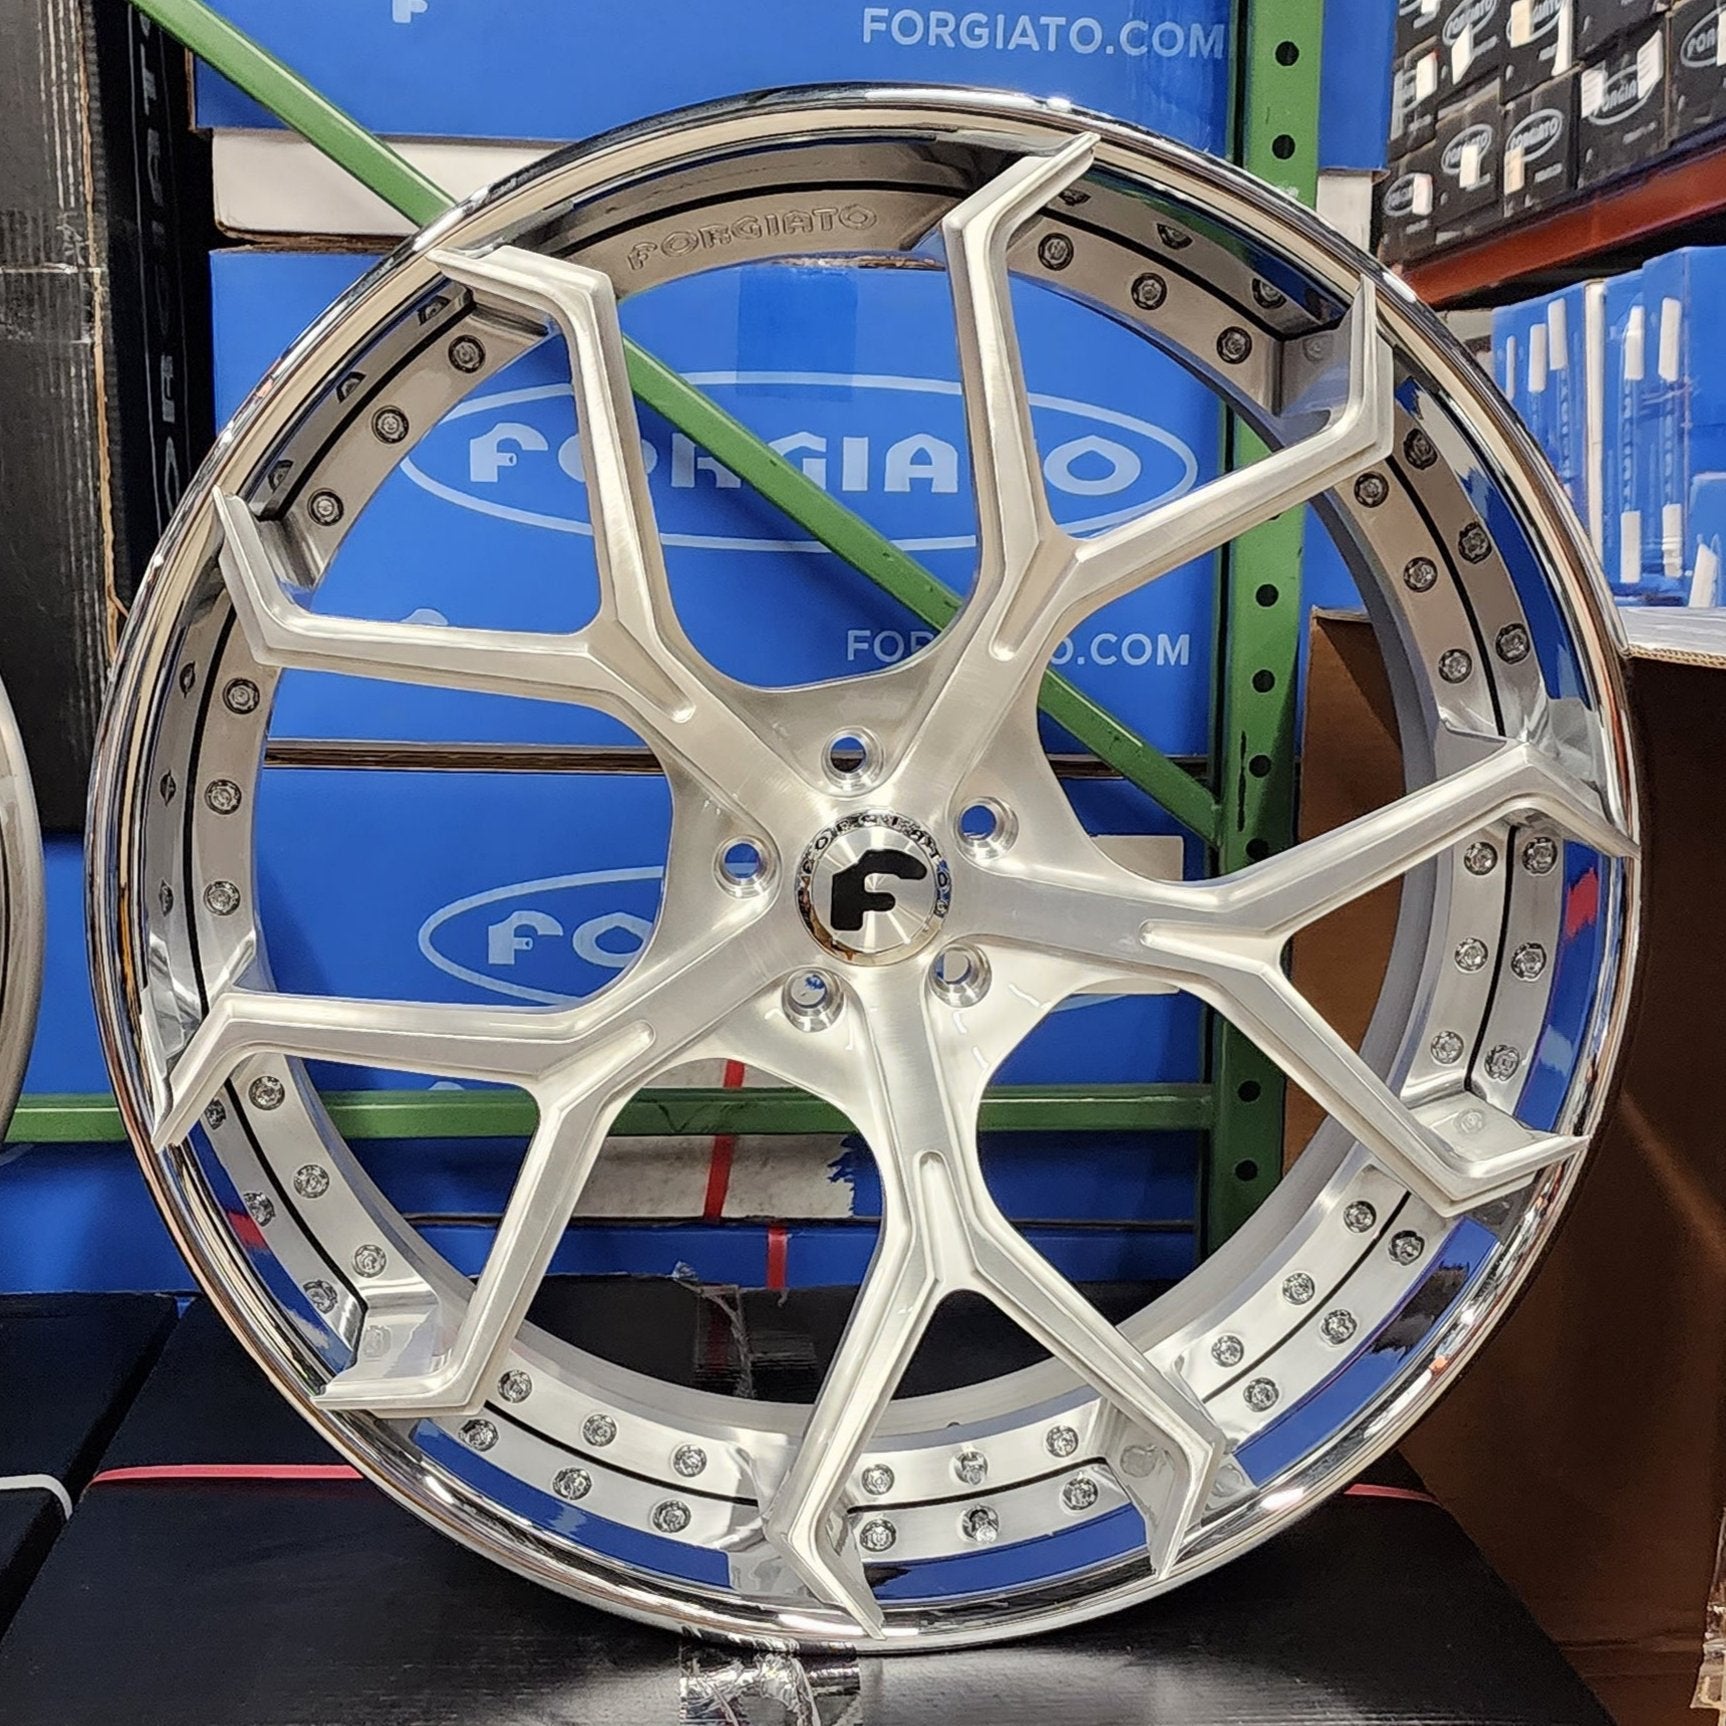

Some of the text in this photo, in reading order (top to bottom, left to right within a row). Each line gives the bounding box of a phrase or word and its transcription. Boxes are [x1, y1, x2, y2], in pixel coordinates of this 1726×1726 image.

[862, 7, 1226, 59] FORGIATO.COM
[627, 204, 877, 271] FORGIATO
[831, 848, 928, 931] F
